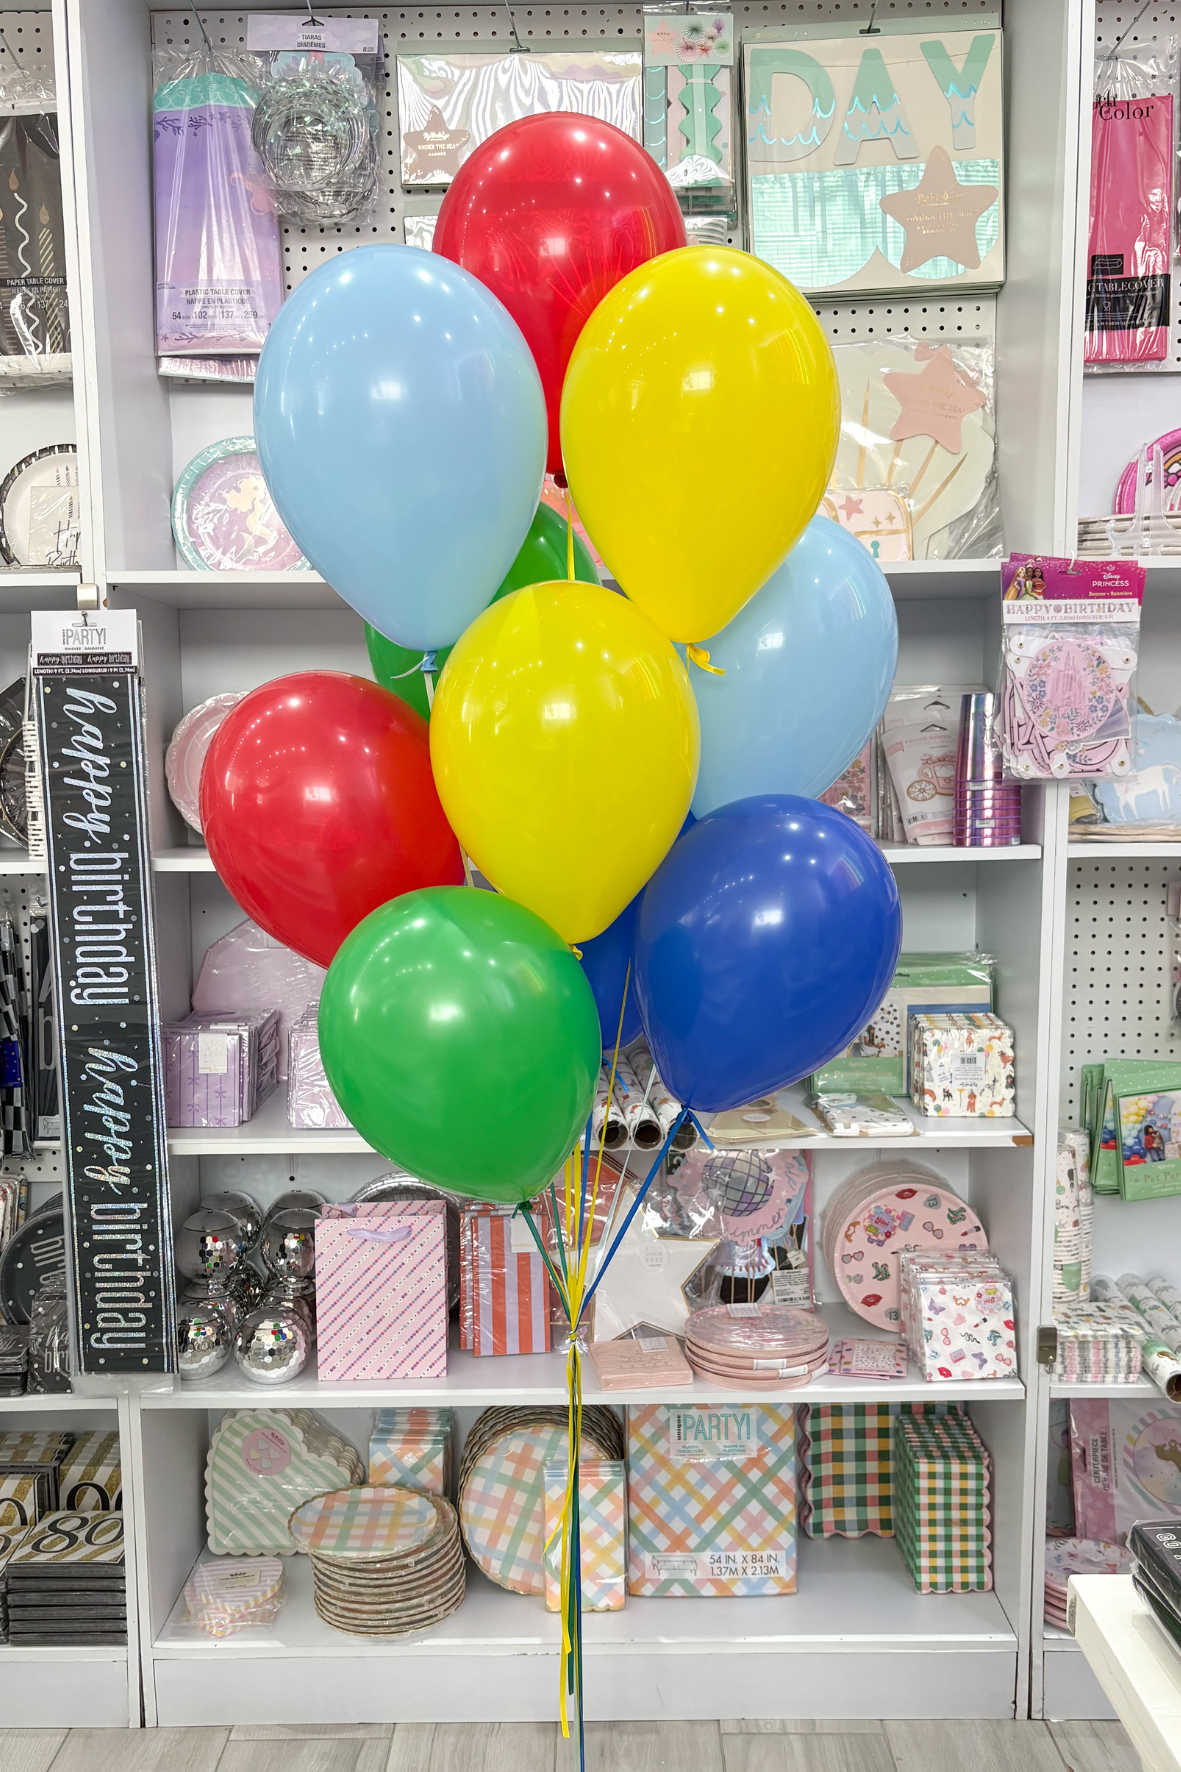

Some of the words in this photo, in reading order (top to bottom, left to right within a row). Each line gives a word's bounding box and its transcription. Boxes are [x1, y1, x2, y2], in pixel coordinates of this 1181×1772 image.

[749, 33, 996, 167] DAY
[1099, 101, 1154, 121] Color
[44, 277, 65, 285] COVER
[1096, 278, 1164, 292] TABLECOVER
[185, 288, 209, 296] PLASTIC
[210, 288, 229, 296] TABLE
[230, 288, 251, 296] COVER
[186, 297, 206, 305] NAPPE
[207, 297, 215, 305] EN
[216, 297, 250, 305] PLASTIQUE
[172, 311, 181, 320] 54
[1101, 571, 1121, 581] Disney
[1006, 603, 1053, 615] HAPPY
[1063, 602, 1136, 614] BIRTHDAY
[65, 627, 107, 646] PARTY!
[61, 686, 119, 844] happy
[68, 852, 136, 1006] birthday
[83, 1046, 139, 1195] happy
[927, 1197, 939, 1208] 13
[89, 1202, 153, 1350] birthday
[888, 1310, 899, 1321] 13
[682, 1412, 751, 1441] PARTY!
[1099, 1430, 1108, 1452] TABLE
[1091, 1437, 1101, 1484] CENTERPIECE
[1101, 1453, 1109, 1463] DE
[31, 1515, 125, 1554] 80
[709, 1554, 723, 1565] 54
[725, 1554, 738, 1565] IN.
[741, 1554, 749, 1564] X
[751, 1553, 764, 1564] 84
[766, 1553, 780, 1564] IN.
[710, 1566, 739, 1577] 1.37M
[741, 1566, 748, 1576] X
[750, 1565, 780, 1576] 2.13M
